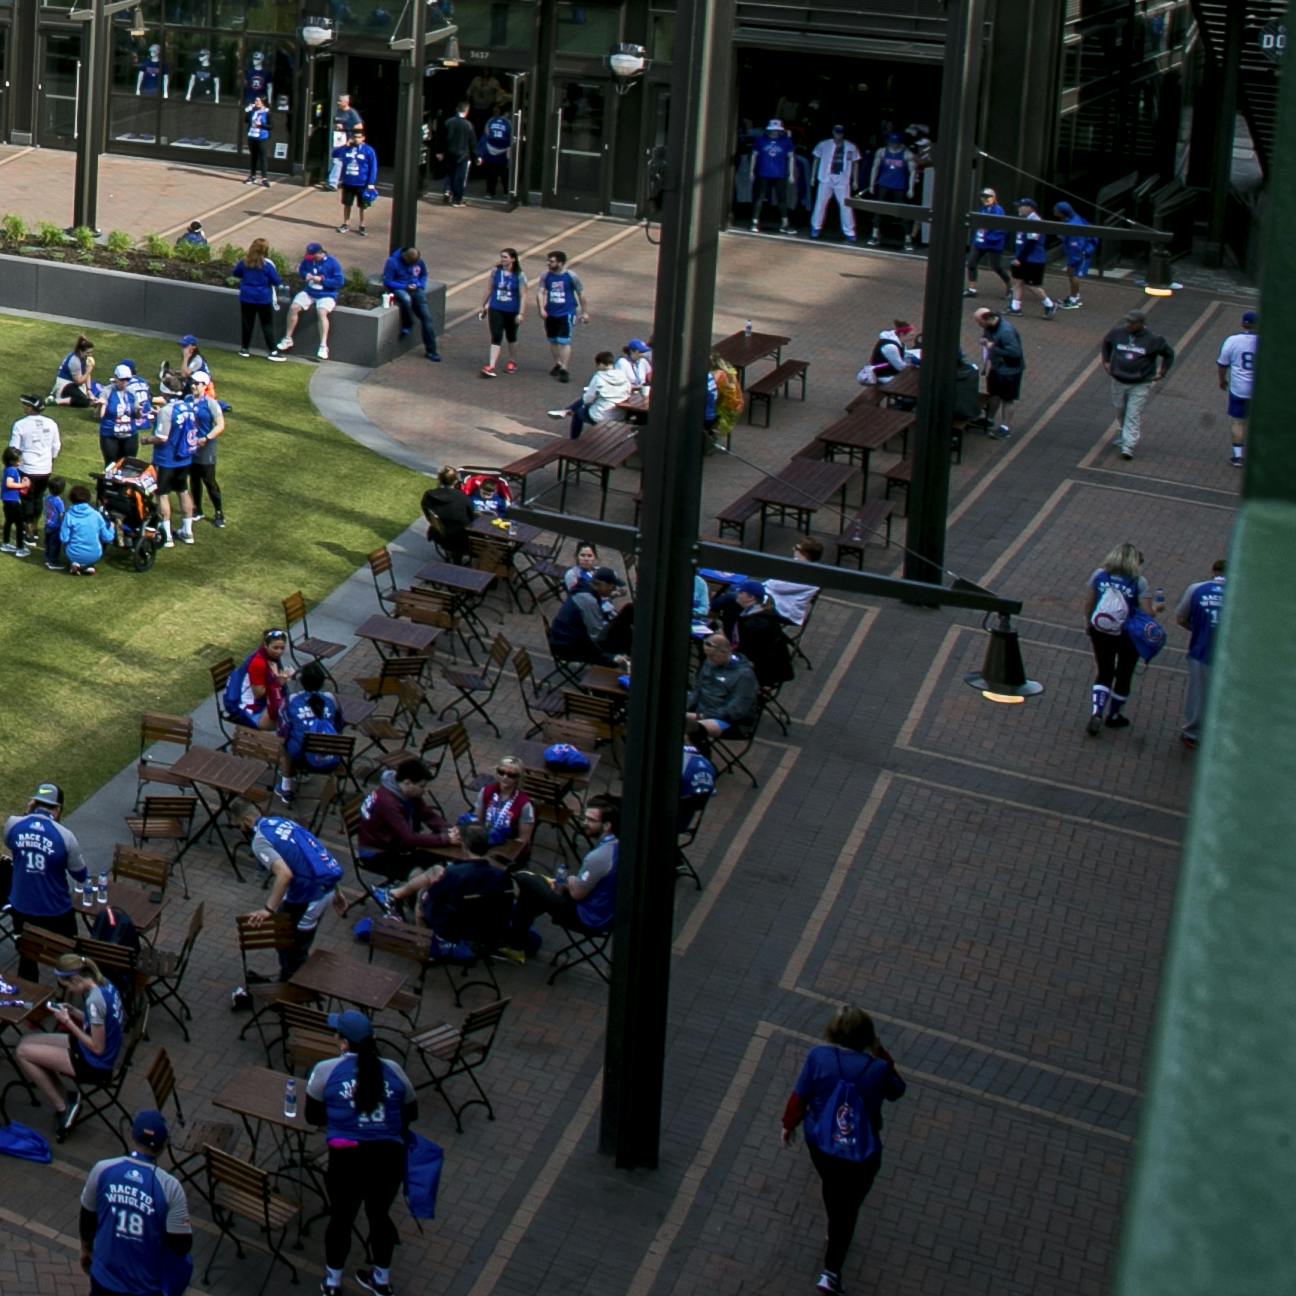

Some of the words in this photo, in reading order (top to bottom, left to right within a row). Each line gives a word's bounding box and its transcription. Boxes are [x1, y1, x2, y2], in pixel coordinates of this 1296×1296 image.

[15, 840, 55, 855] WRIGLEY
[17, 833, 41, 844] RACE
[42, 836, 53, 847] TO
[20, 850, 46, 870] '18
[104, 1192, 156, 1216] WRIGLEY
[109, 1184, 138, 1201] RACE
[139, 1191, 153, 1205] TO
[111, 1206, 144, 1236] '18
